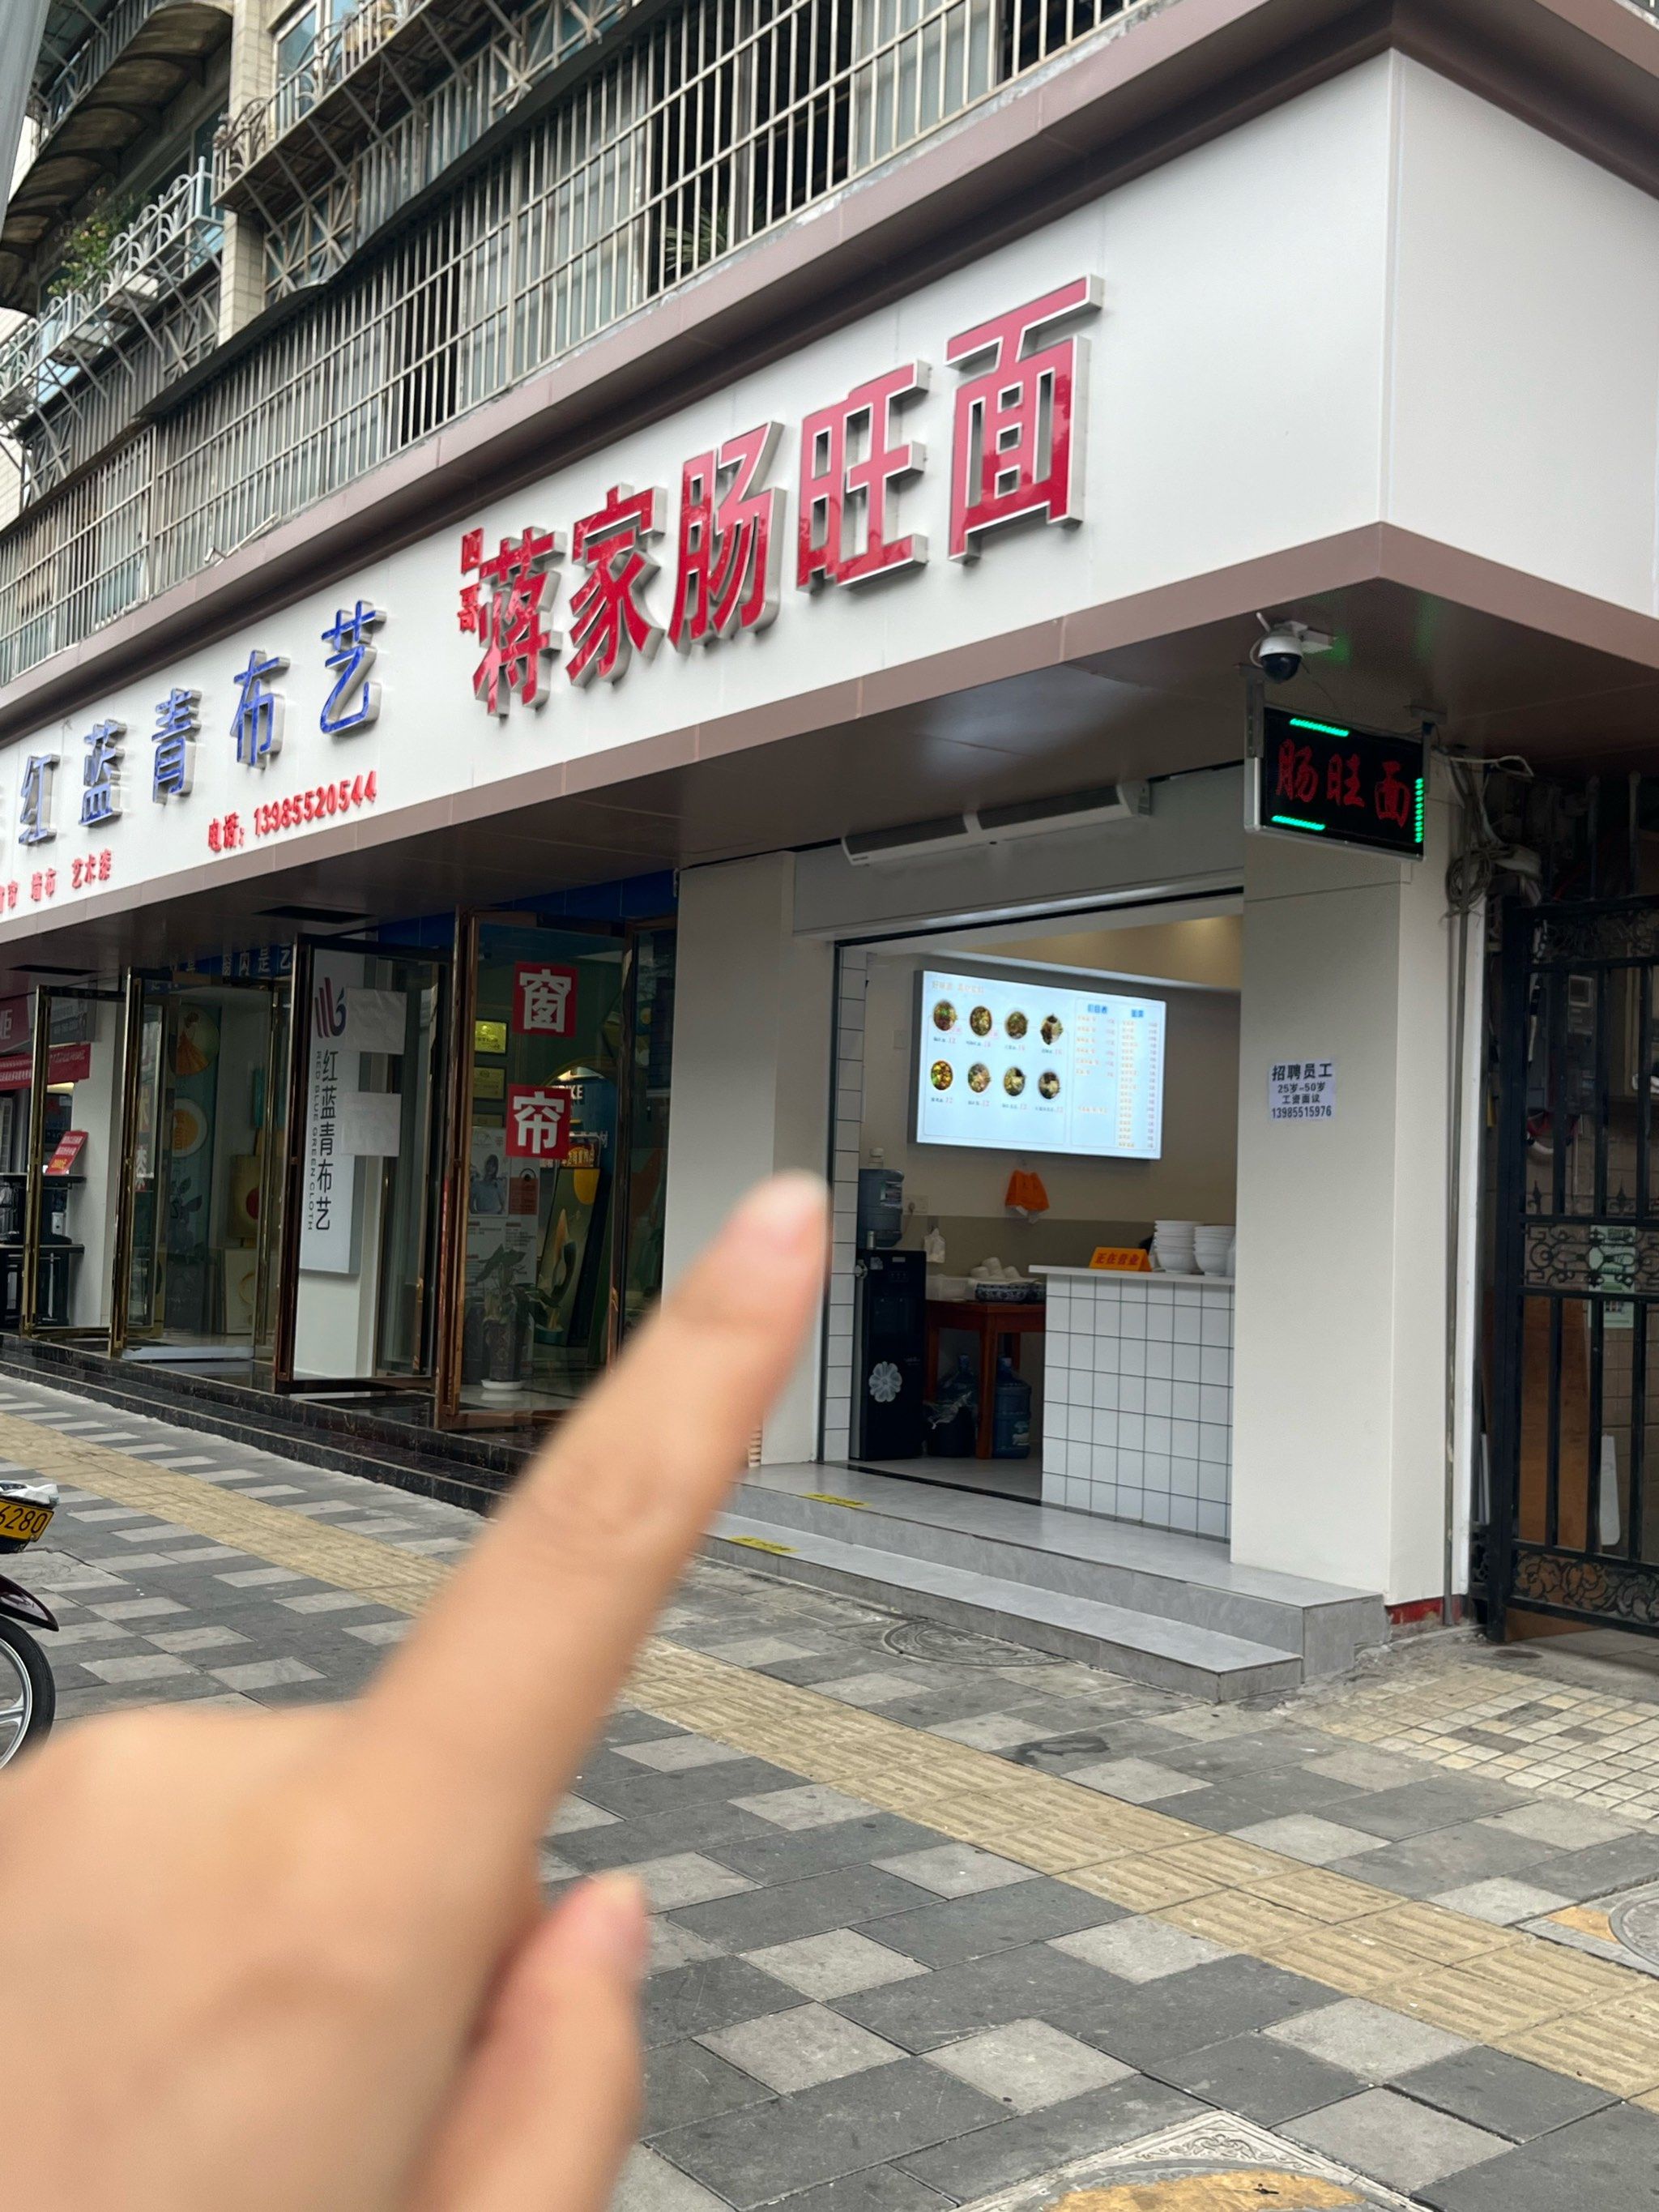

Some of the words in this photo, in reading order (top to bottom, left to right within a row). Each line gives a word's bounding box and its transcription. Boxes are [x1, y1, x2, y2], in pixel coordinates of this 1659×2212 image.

[473, 275, 1103, 717] 蒋家肠旺面
[19, 600, 386, 845] 红蓝青布艺
[1276, 738, 1410, 828] 肠旺面
[519, 968, 572, 1033] 窗
[1272, 1063, 1333, 1082] 招聘员工
[1277, 1082, 1325, 1094] 25岁-50岁
[1282, 1094, 1320, 1104] 工资面议
[316, 1049, 338, 1230] 红蓝青布艺
[513, 1091, 565, 1154] 帘
[1272, 1105, 1332, 1118] 13985515976
